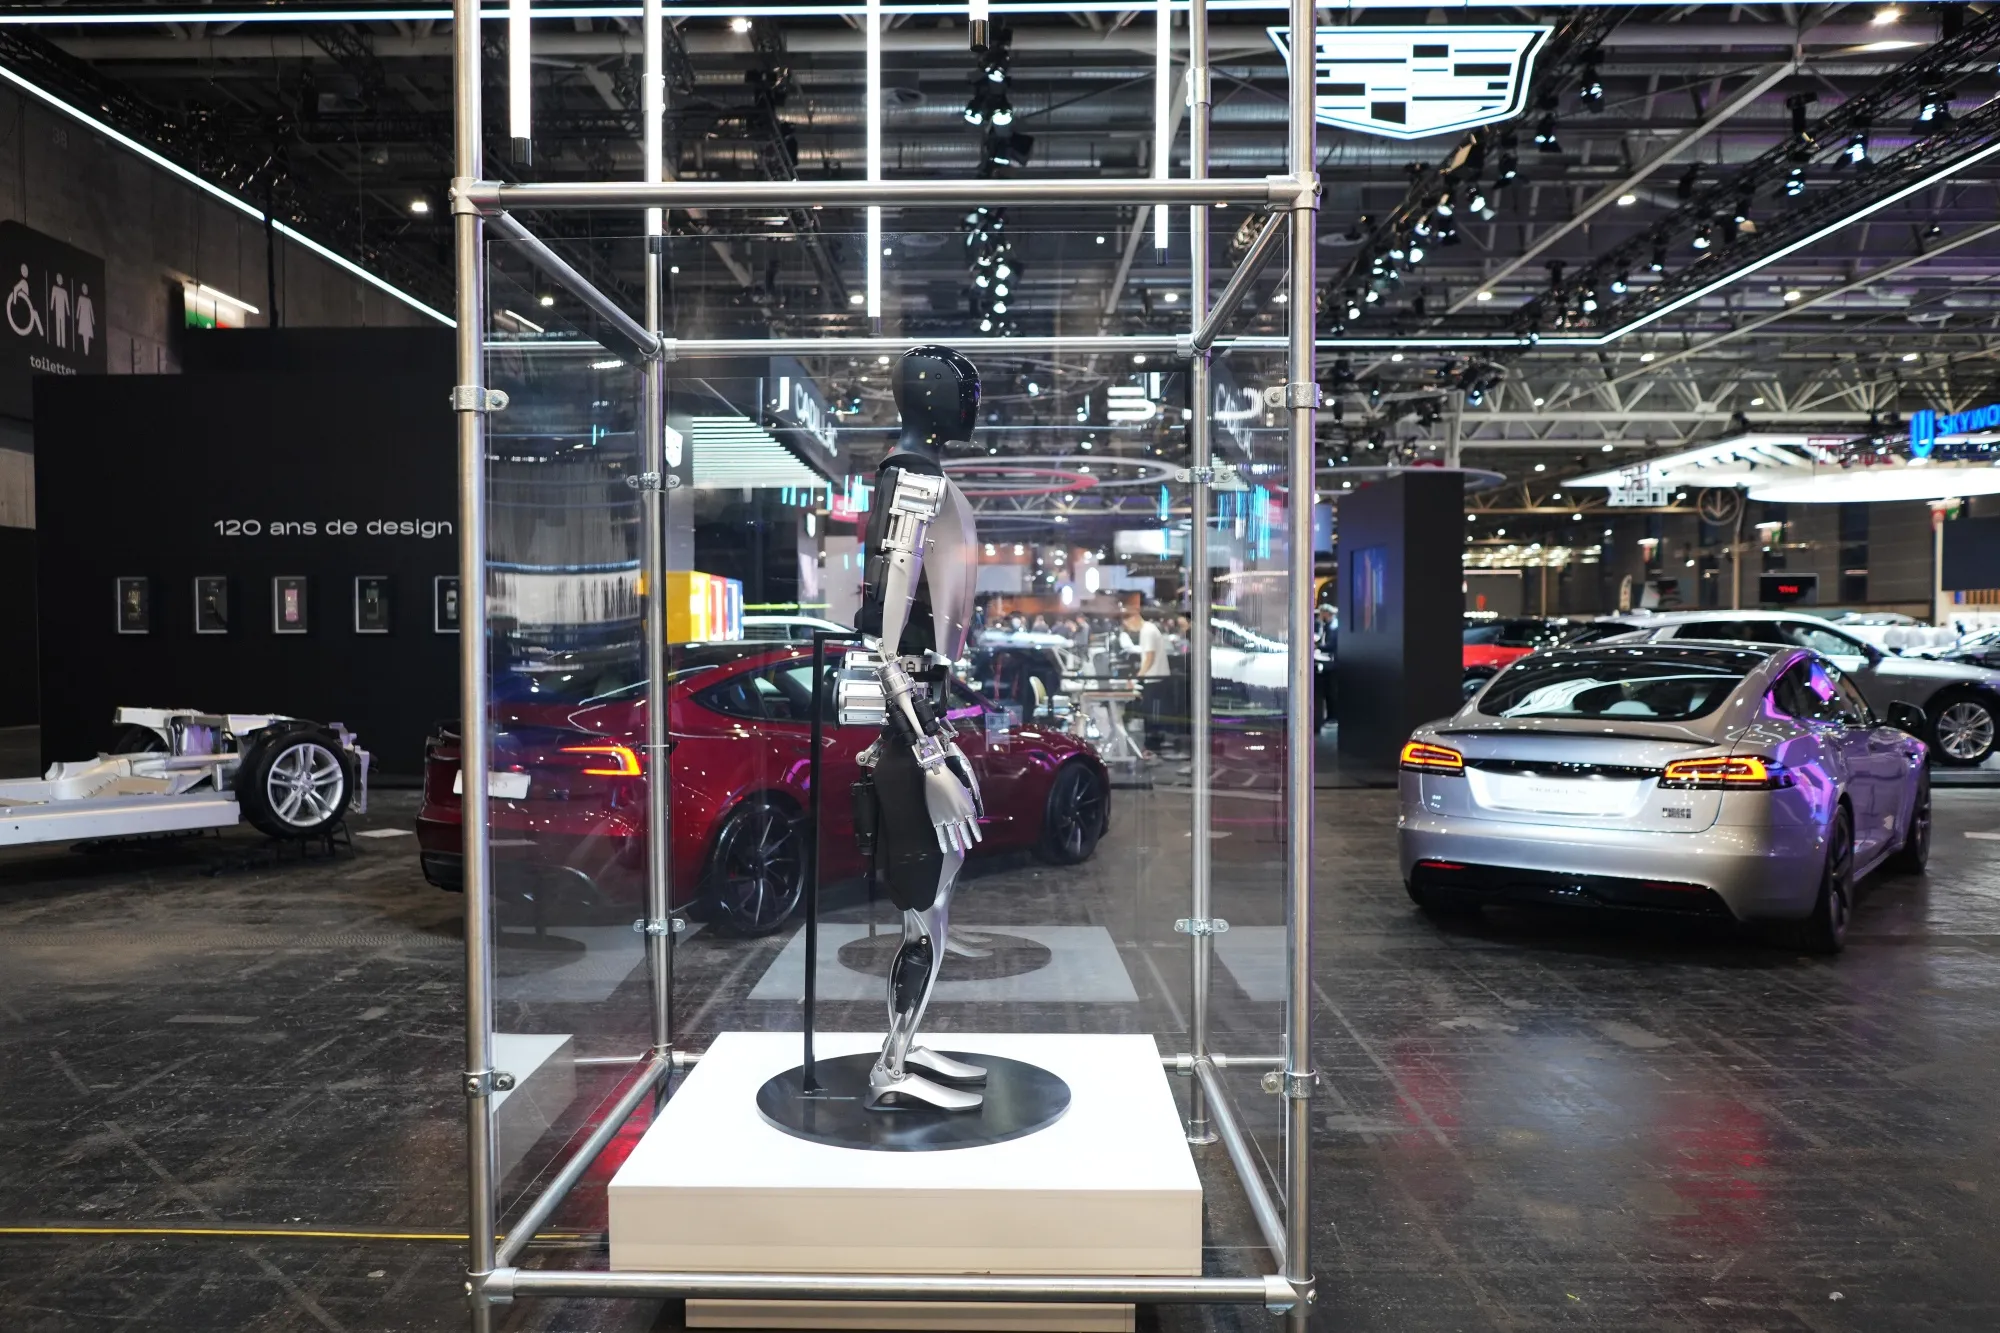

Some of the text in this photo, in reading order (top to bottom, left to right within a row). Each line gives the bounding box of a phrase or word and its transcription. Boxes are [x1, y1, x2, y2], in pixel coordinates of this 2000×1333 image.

[214, 518, 453, 539] 120 ans de design
